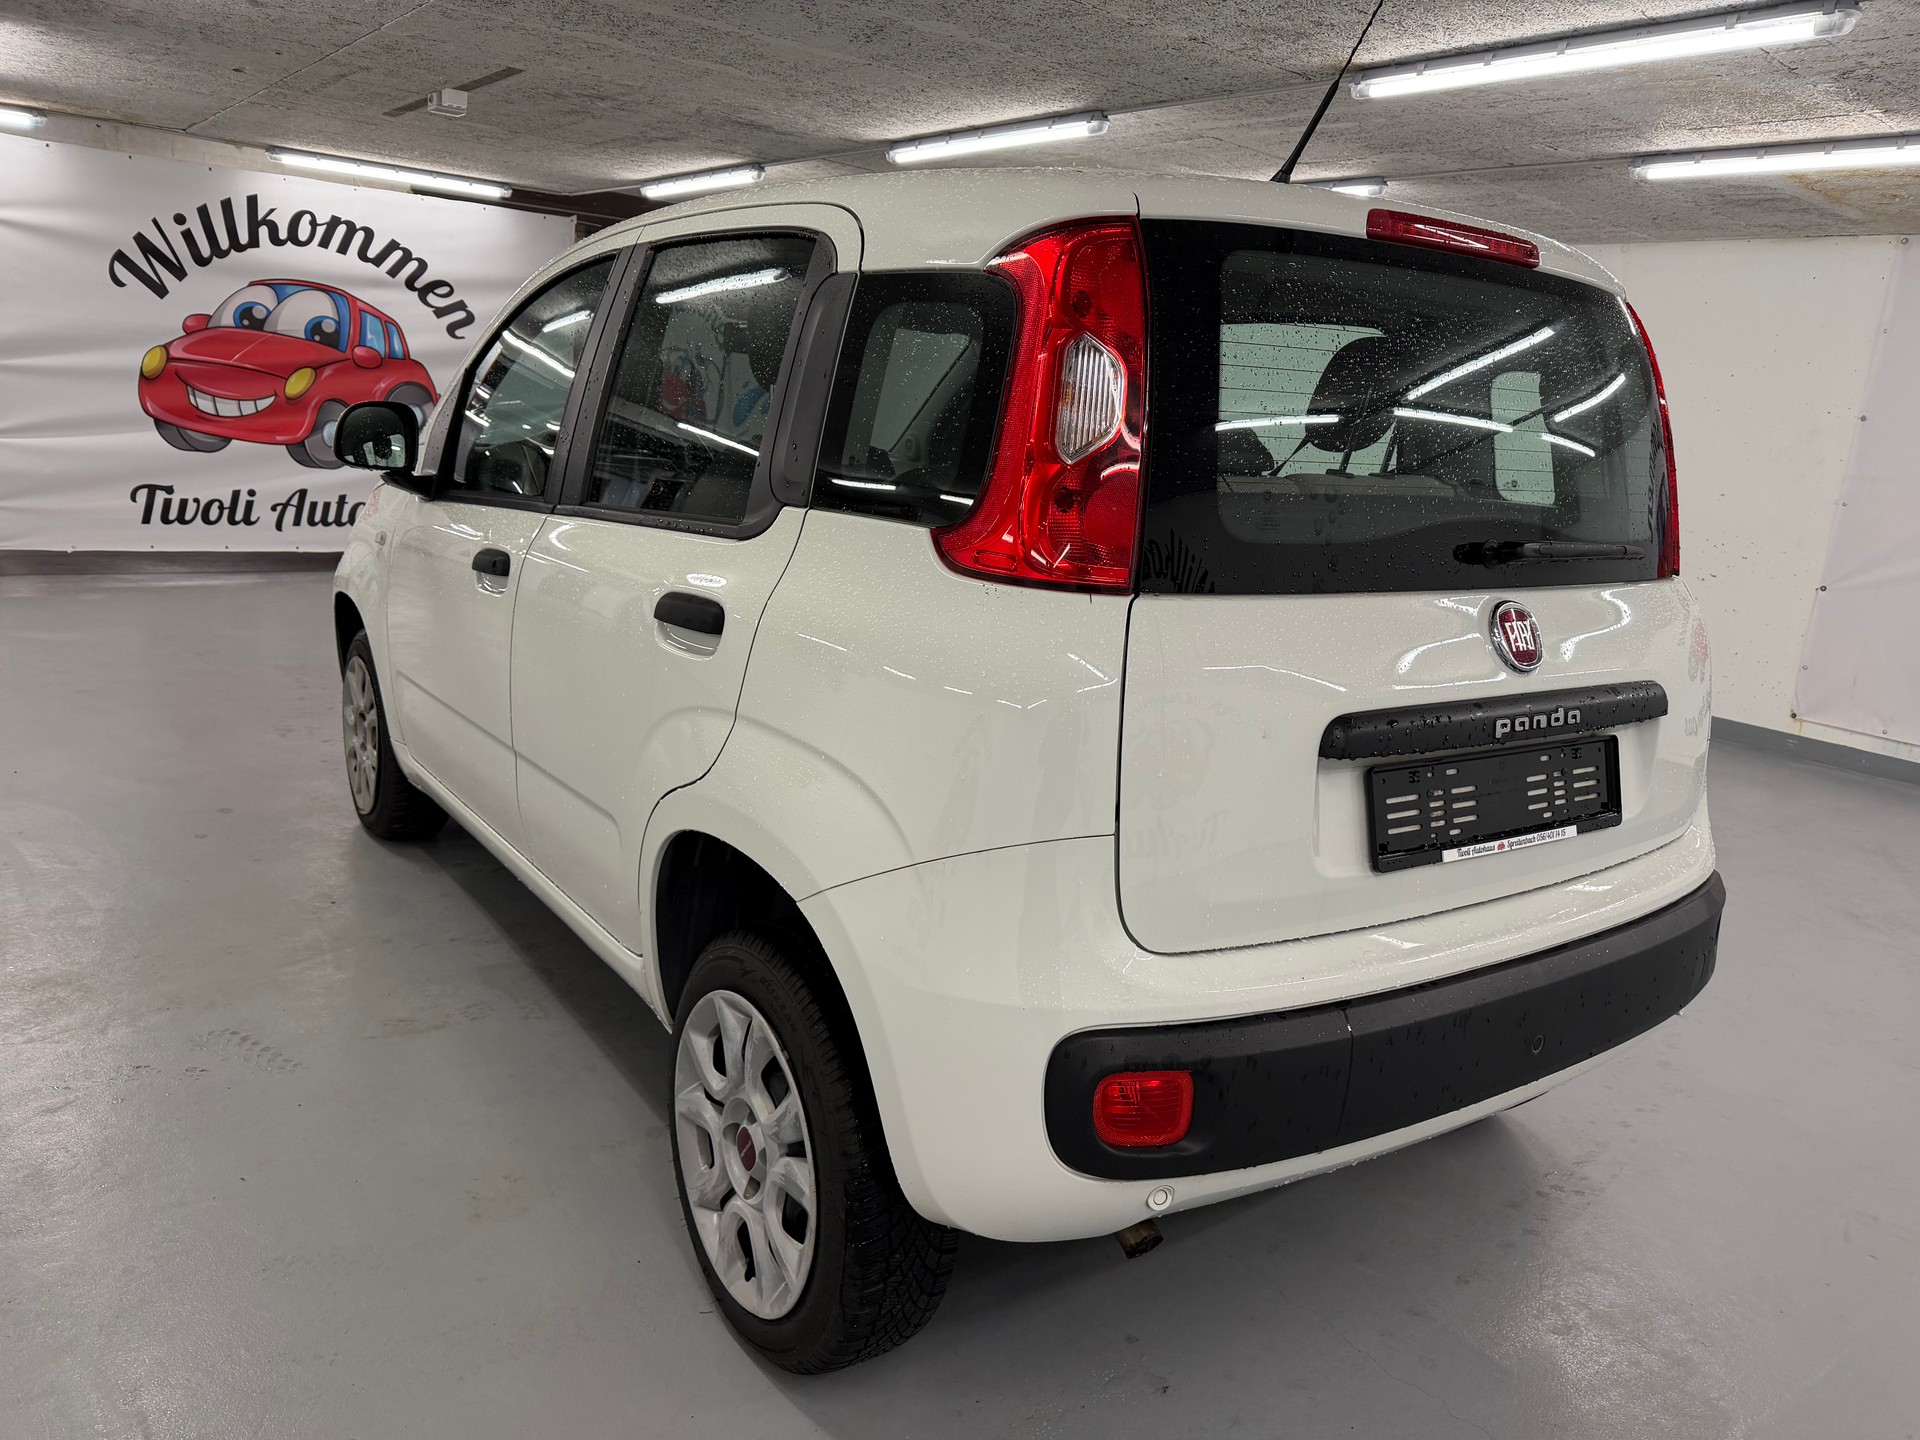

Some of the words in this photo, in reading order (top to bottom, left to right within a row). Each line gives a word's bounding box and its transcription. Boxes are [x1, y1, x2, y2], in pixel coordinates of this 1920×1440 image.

[108, 193, 476, 340] Willkommen
[129, 483, 261, 527] Tivoli
[1504, 618, 1536, 653] FIAT
[1495, 706, 1581, 739] panda
